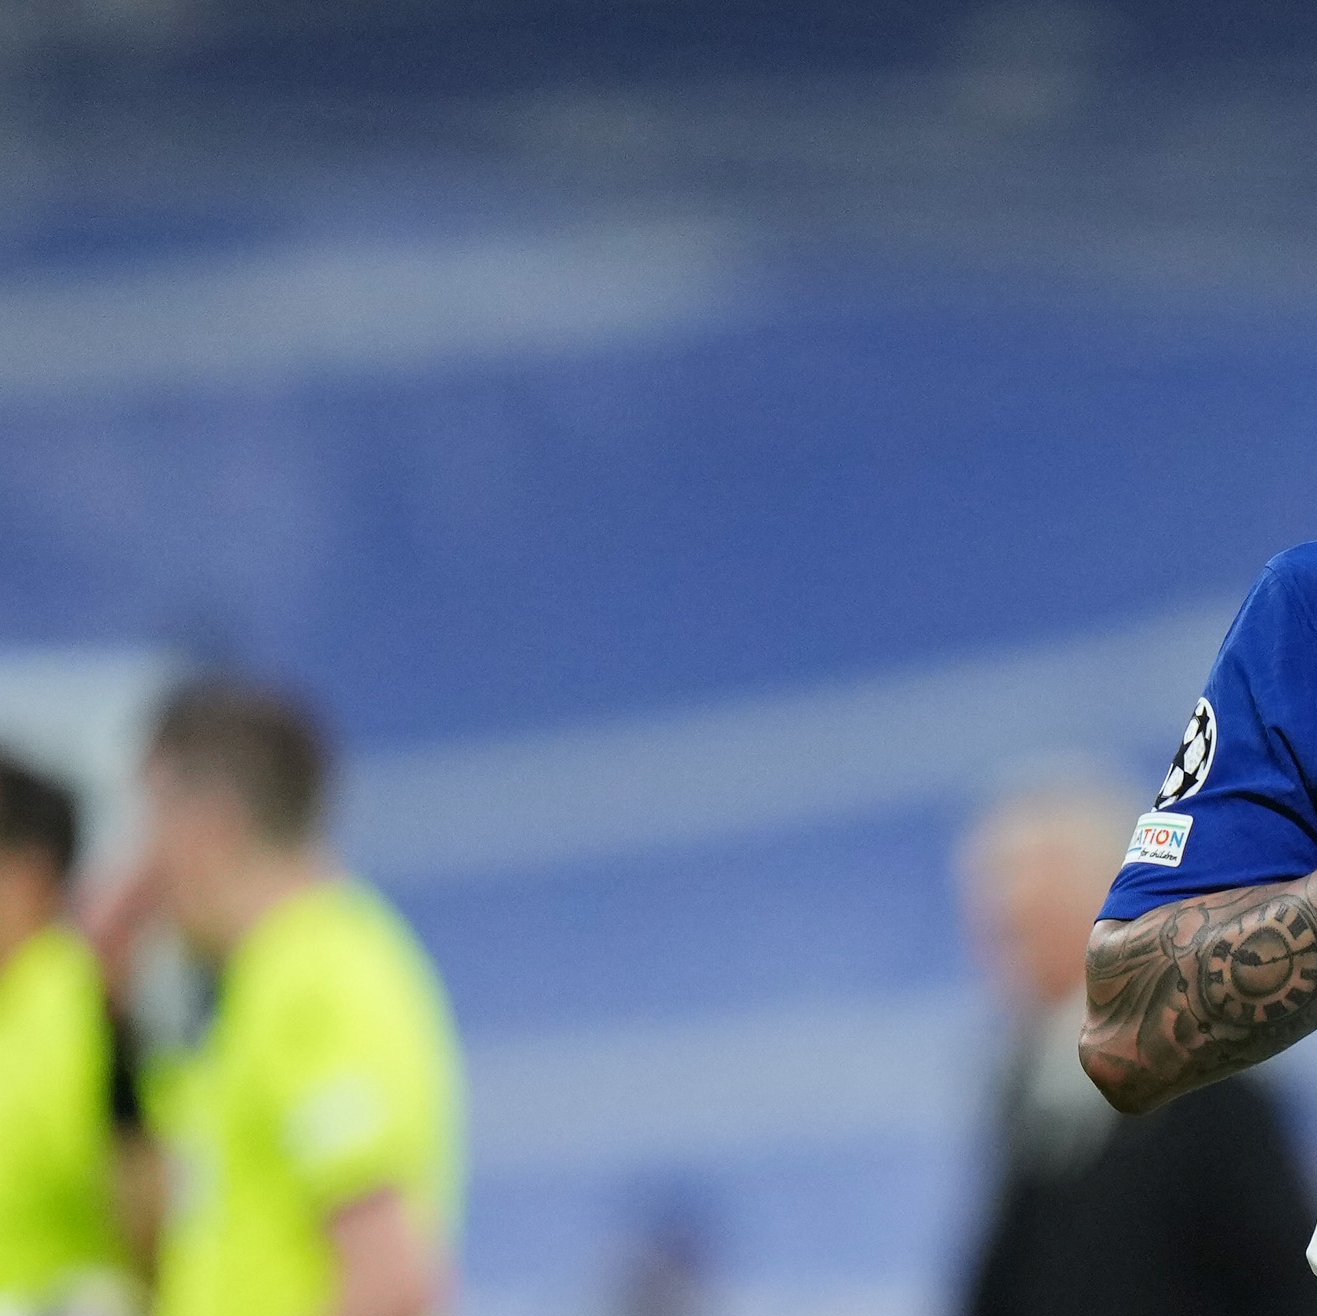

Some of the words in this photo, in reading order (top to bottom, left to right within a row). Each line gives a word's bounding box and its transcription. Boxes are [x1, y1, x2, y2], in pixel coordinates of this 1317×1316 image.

[1134, 828, 1185, 848] ATiON
[1138, 848, 1149, 859] for
[1149, 849, 1178, 861] children
